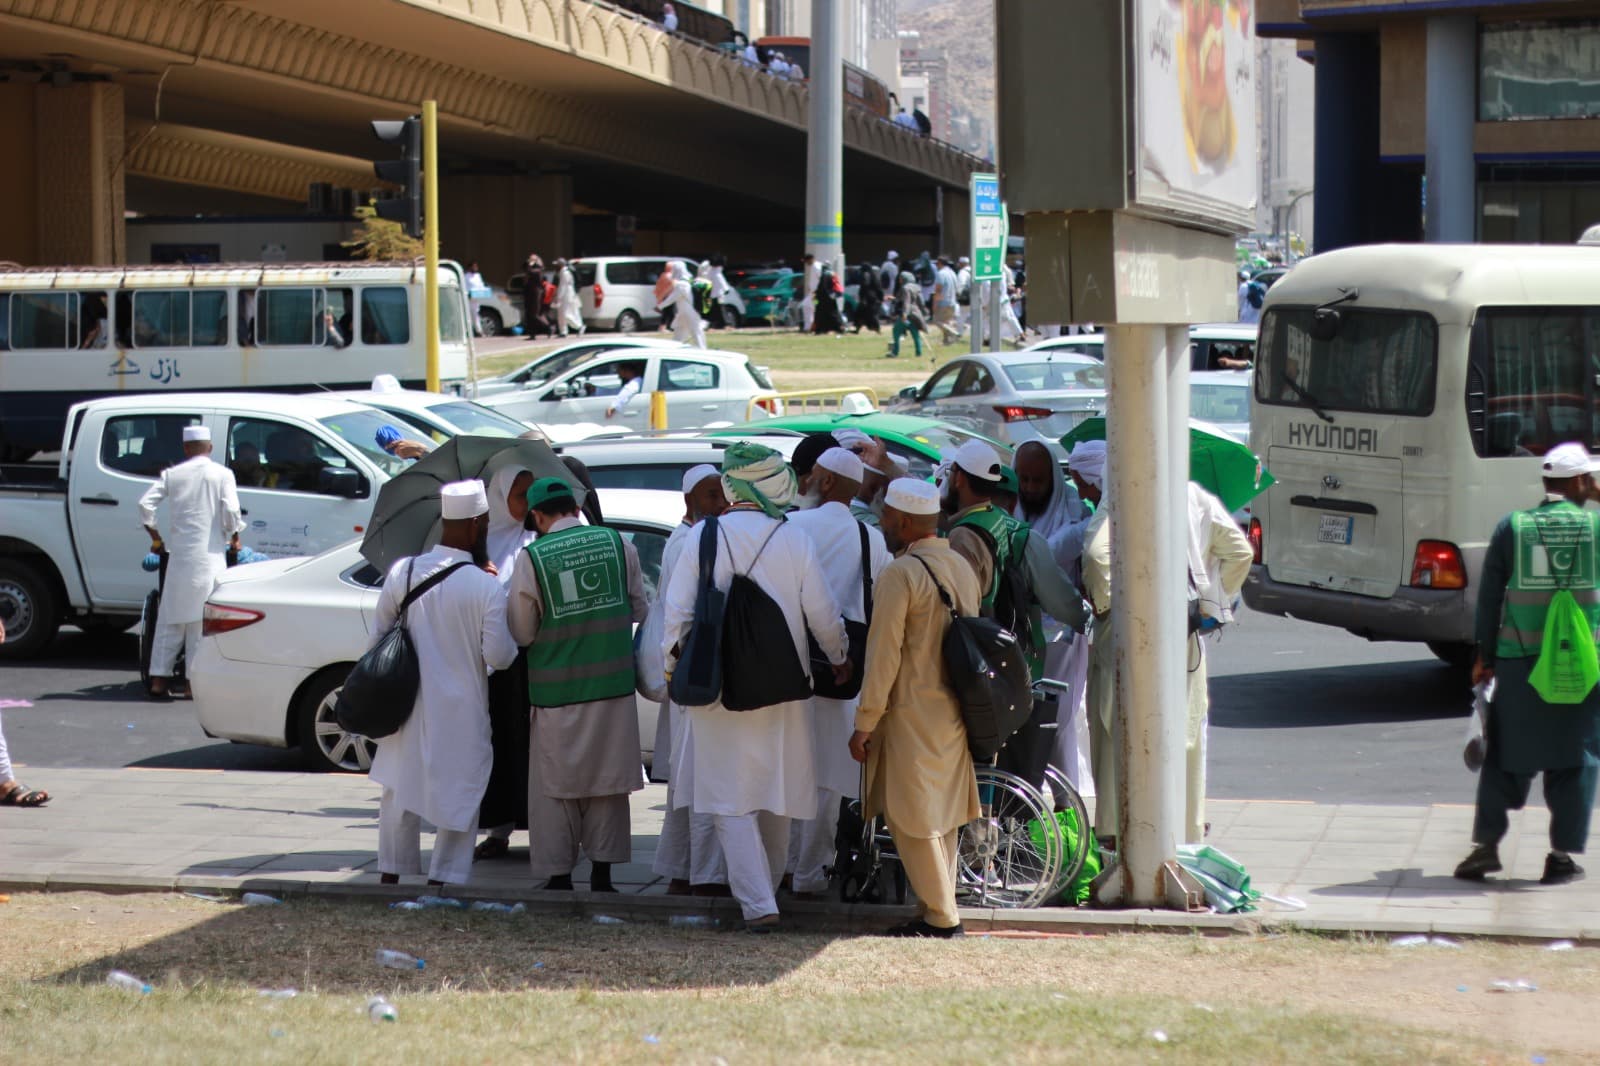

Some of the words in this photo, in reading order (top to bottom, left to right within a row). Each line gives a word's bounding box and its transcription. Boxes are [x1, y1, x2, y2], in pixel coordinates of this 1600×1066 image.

[1289, 422, 1378, 452] HYUNDAI
[541, 533, 607, 552] www.phvg.com
[564, 556, 587, 567] Saudi
[589, 551, 616, 562] Arabia
